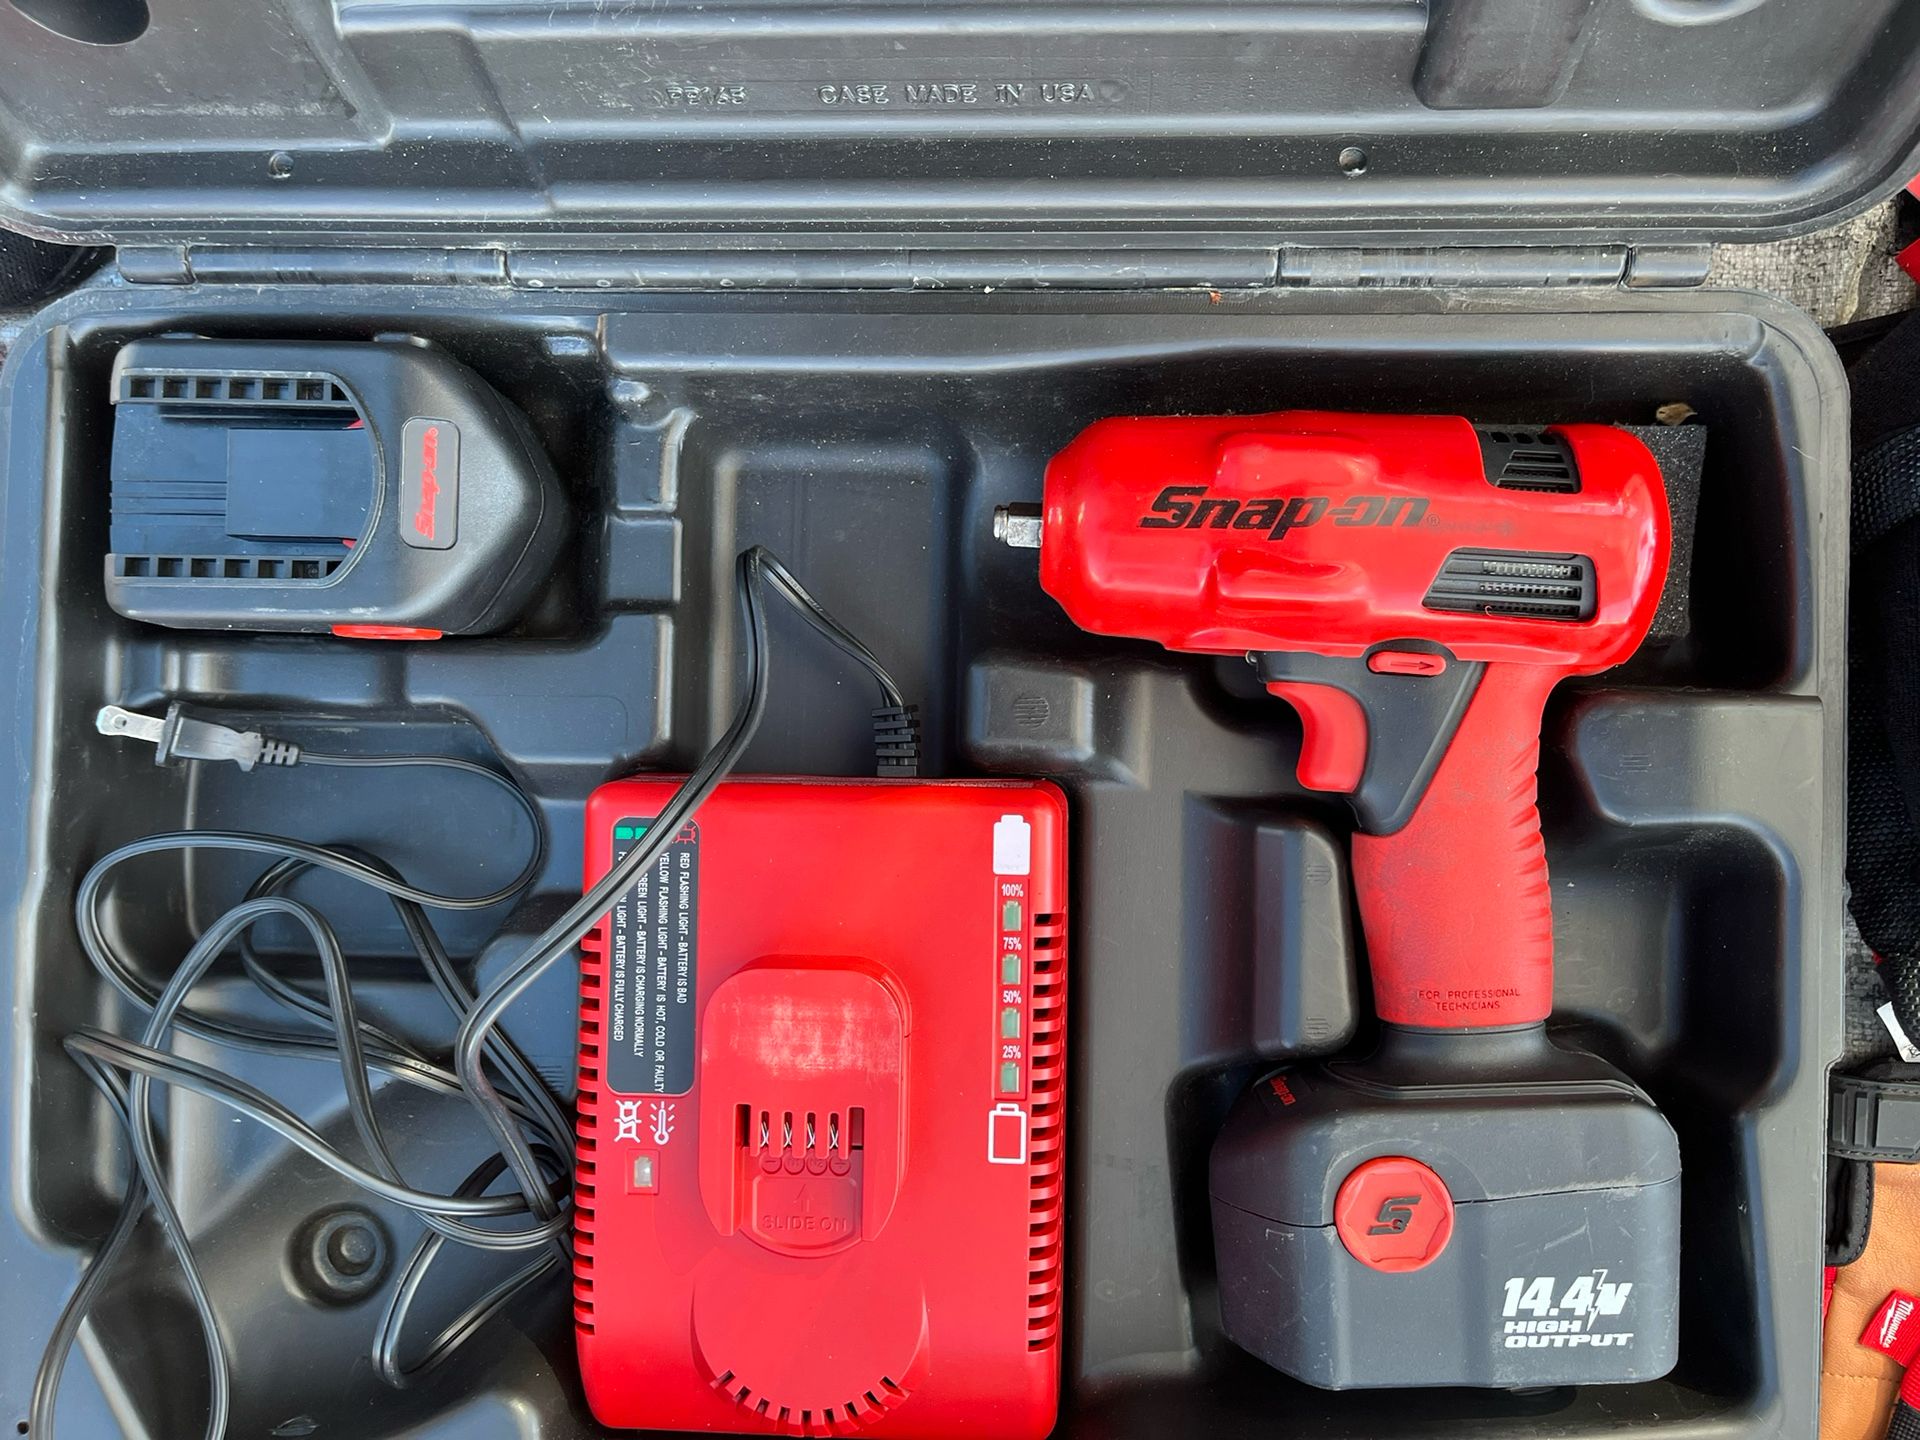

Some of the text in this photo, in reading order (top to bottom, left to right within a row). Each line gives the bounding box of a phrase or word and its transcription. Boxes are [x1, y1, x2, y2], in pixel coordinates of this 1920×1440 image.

[818, 85, 889, 104] CASE
[905, 84, 977, 103] MADE
[995, 83, 1023, 102] IN
[1040, 82, 1095, 103] USA
[659, 852, 670, 884] YELLOW
[679, 852, 690, 869] RED
[678, 872, 690, 910] FLASHING
[1001, 883, 1024, 897] 100%
[637, 901, 647, 924] LIGHT
[658, 886, 669, 924] FLASHING
[616, 905, 626, 928] LIGHT
[678, 912, 688, 935] LIGHT
[635, 930, 647, 966] BATTERY
[657, 927, 668, 950] LIGHT
[1003, 937, 1021, 950] 75%
[615, 935, 626, 970] BATTERY
[677, 942, 688, 977] BATTERY
[614, 970, 625, 978] IS
[635, 966, 645, 974] IS
[656, 956, 667, 991] BATTERY
[614, 980, 625, 1003] FULLY
[677, 978, 687, 986] IS
[634, 974, 645, 1015] CHARGING
[656, 994, 666, 1002] IS
[676, 987, 687, 1004] BAD
[1003, 990, 1021, 1004] 50%
[1418, 987, 1521, 1000] FOR PROFESSIONAL
[655, 1005, 666, 1024] HOT,
[1436, 1000, 1500, 1011] TECHNICIANS
[613, 1004, 624, 1042] CHARGED
[633, 1016, 645, 1057] NORMALLY
[655, 1025, 665, 1047] COLD
[655, 1049, 665, 1062] OR
[1003, 1045, 1021, 1059] 25%
[654, 1064, 665, 1093] FAULTY
[762, 1214, 848, 1232] SLIDE ON
[1503, 1319, 1582, 1334] HIGH
[1882, 1299, 1914, 1348] Milwaukee
[1504, 1332, 1634, 1348] OUTPUT
